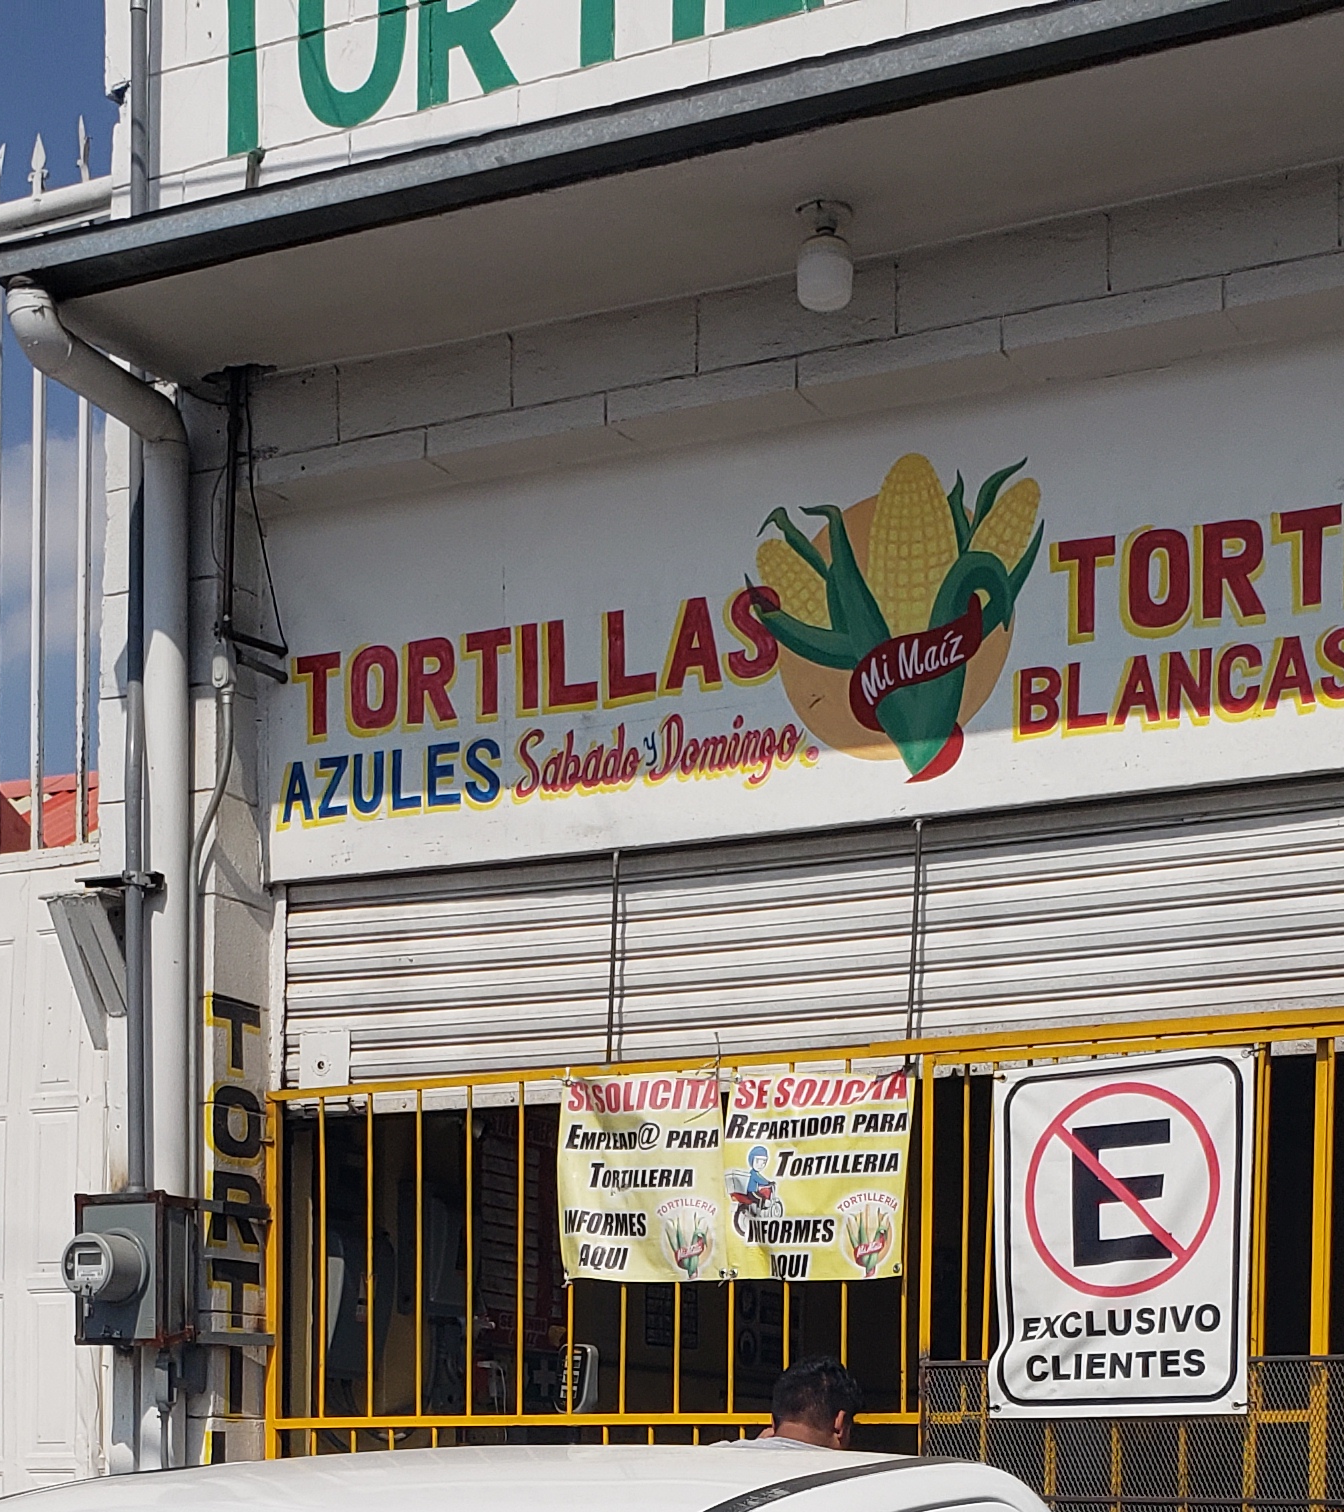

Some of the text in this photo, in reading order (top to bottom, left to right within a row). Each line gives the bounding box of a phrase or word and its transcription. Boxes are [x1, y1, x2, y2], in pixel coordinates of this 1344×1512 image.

[292, 585, 781, 742] TORTILLAS
[861, 654, 895, 705] Mi
[279, 738, 502, 829] AZULES
[592, 1079, 719, 1113] SOLICITA
[734, 1079, 772, 1109] SE
[666, 1129, 719, 1149] PARA
[725, 1113, 908, 1139] REPARTIDOR PARA
[590, 1162, 693, 1189] TORTILLERIA
[776, 1151, 899, 1177] TORTILLERIA
[1072, 1118, 1172, 1267] E
[564, 1210, 647, 1236] INFORMES
[747, 1219, 834, 1243] INFORMES
[579, 1244, 628, 1270] AQUI
[771, 1254, 809, 1278] AQUI
[1020, 1304, 1221, 1342] EXCLUSIVO
[1026, 1349, 1206, 1382] CLIENTES
